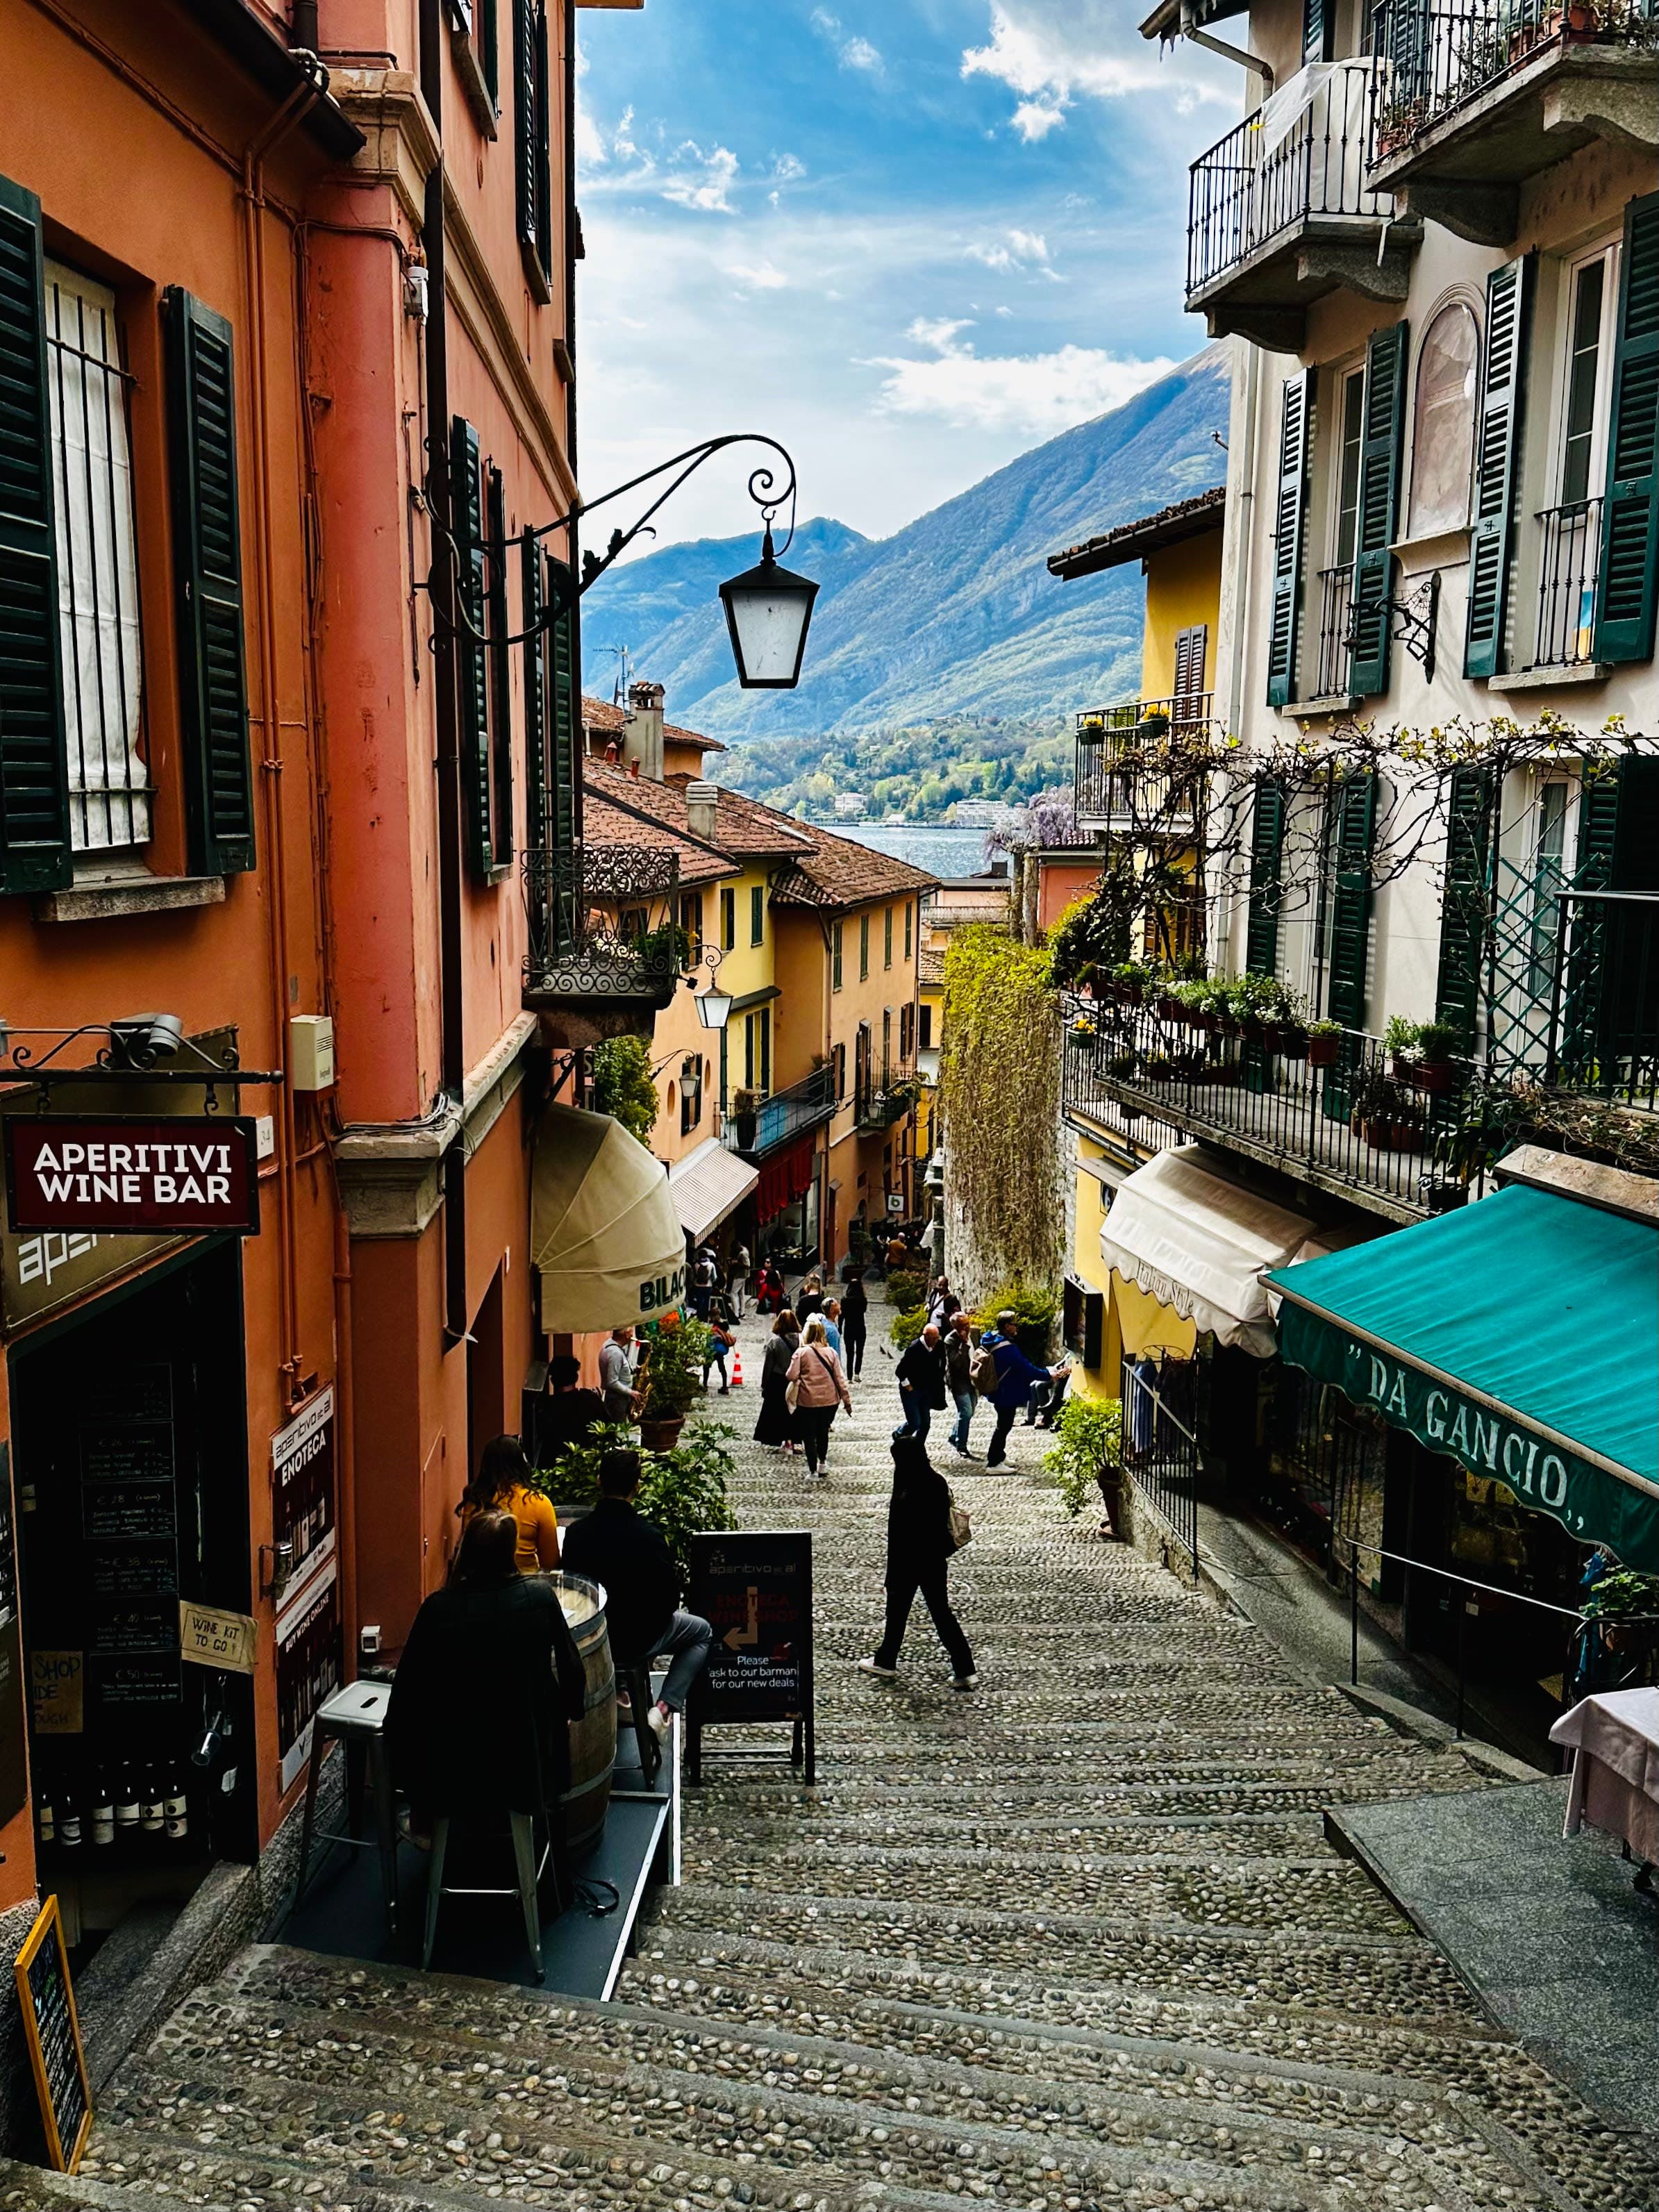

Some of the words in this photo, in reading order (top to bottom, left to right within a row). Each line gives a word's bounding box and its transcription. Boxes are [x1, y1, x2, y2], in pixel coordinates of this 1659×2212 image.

[33, 1143, 233, 1173] APERITIVI
[37, 1174, 142, 1203] WINE
[154, 1175, 231, 1204] BAR
[1135, 1260, 1167, 1298] Italian
[1169, 1281, 1195, 1314] Style
[281, 1429, 326, 1488] ENOTECA
[709, 1564, 772, 1576] aperitivo
[716, 1595, 790, 1607] ENOTECA
[285, 1634, 297, 1654] BUY
[297, 1615, 311, 1638] WINE
[310, 1592, 330, 1621] ONLINE
[707, 1611, 750, 1622] WINE
[753, 1611, 800, 1622] SHOP
[193, 1617, 218, 1635] WINE
[224, 1625, 240, 1640] KIT
[195, 1633, 208, 1647] TO
[213, 1638, 228, 1652] GO
[35, 1655, 81, 1681] SHOP
[709, 1668, 726, 1678] ask
[728, 1668, 740, 1677] to
[741, 1669, 757, 1677] our
[760, 1665, 797, 1676] barman
[737, 1656, 769, 1666] Please
[712, 1679, 727, 1689] for
[728, 1680, 746, 1689] our
[747, 1679, 767, 1688] new
[769, 1677, 795, 1688] deals
